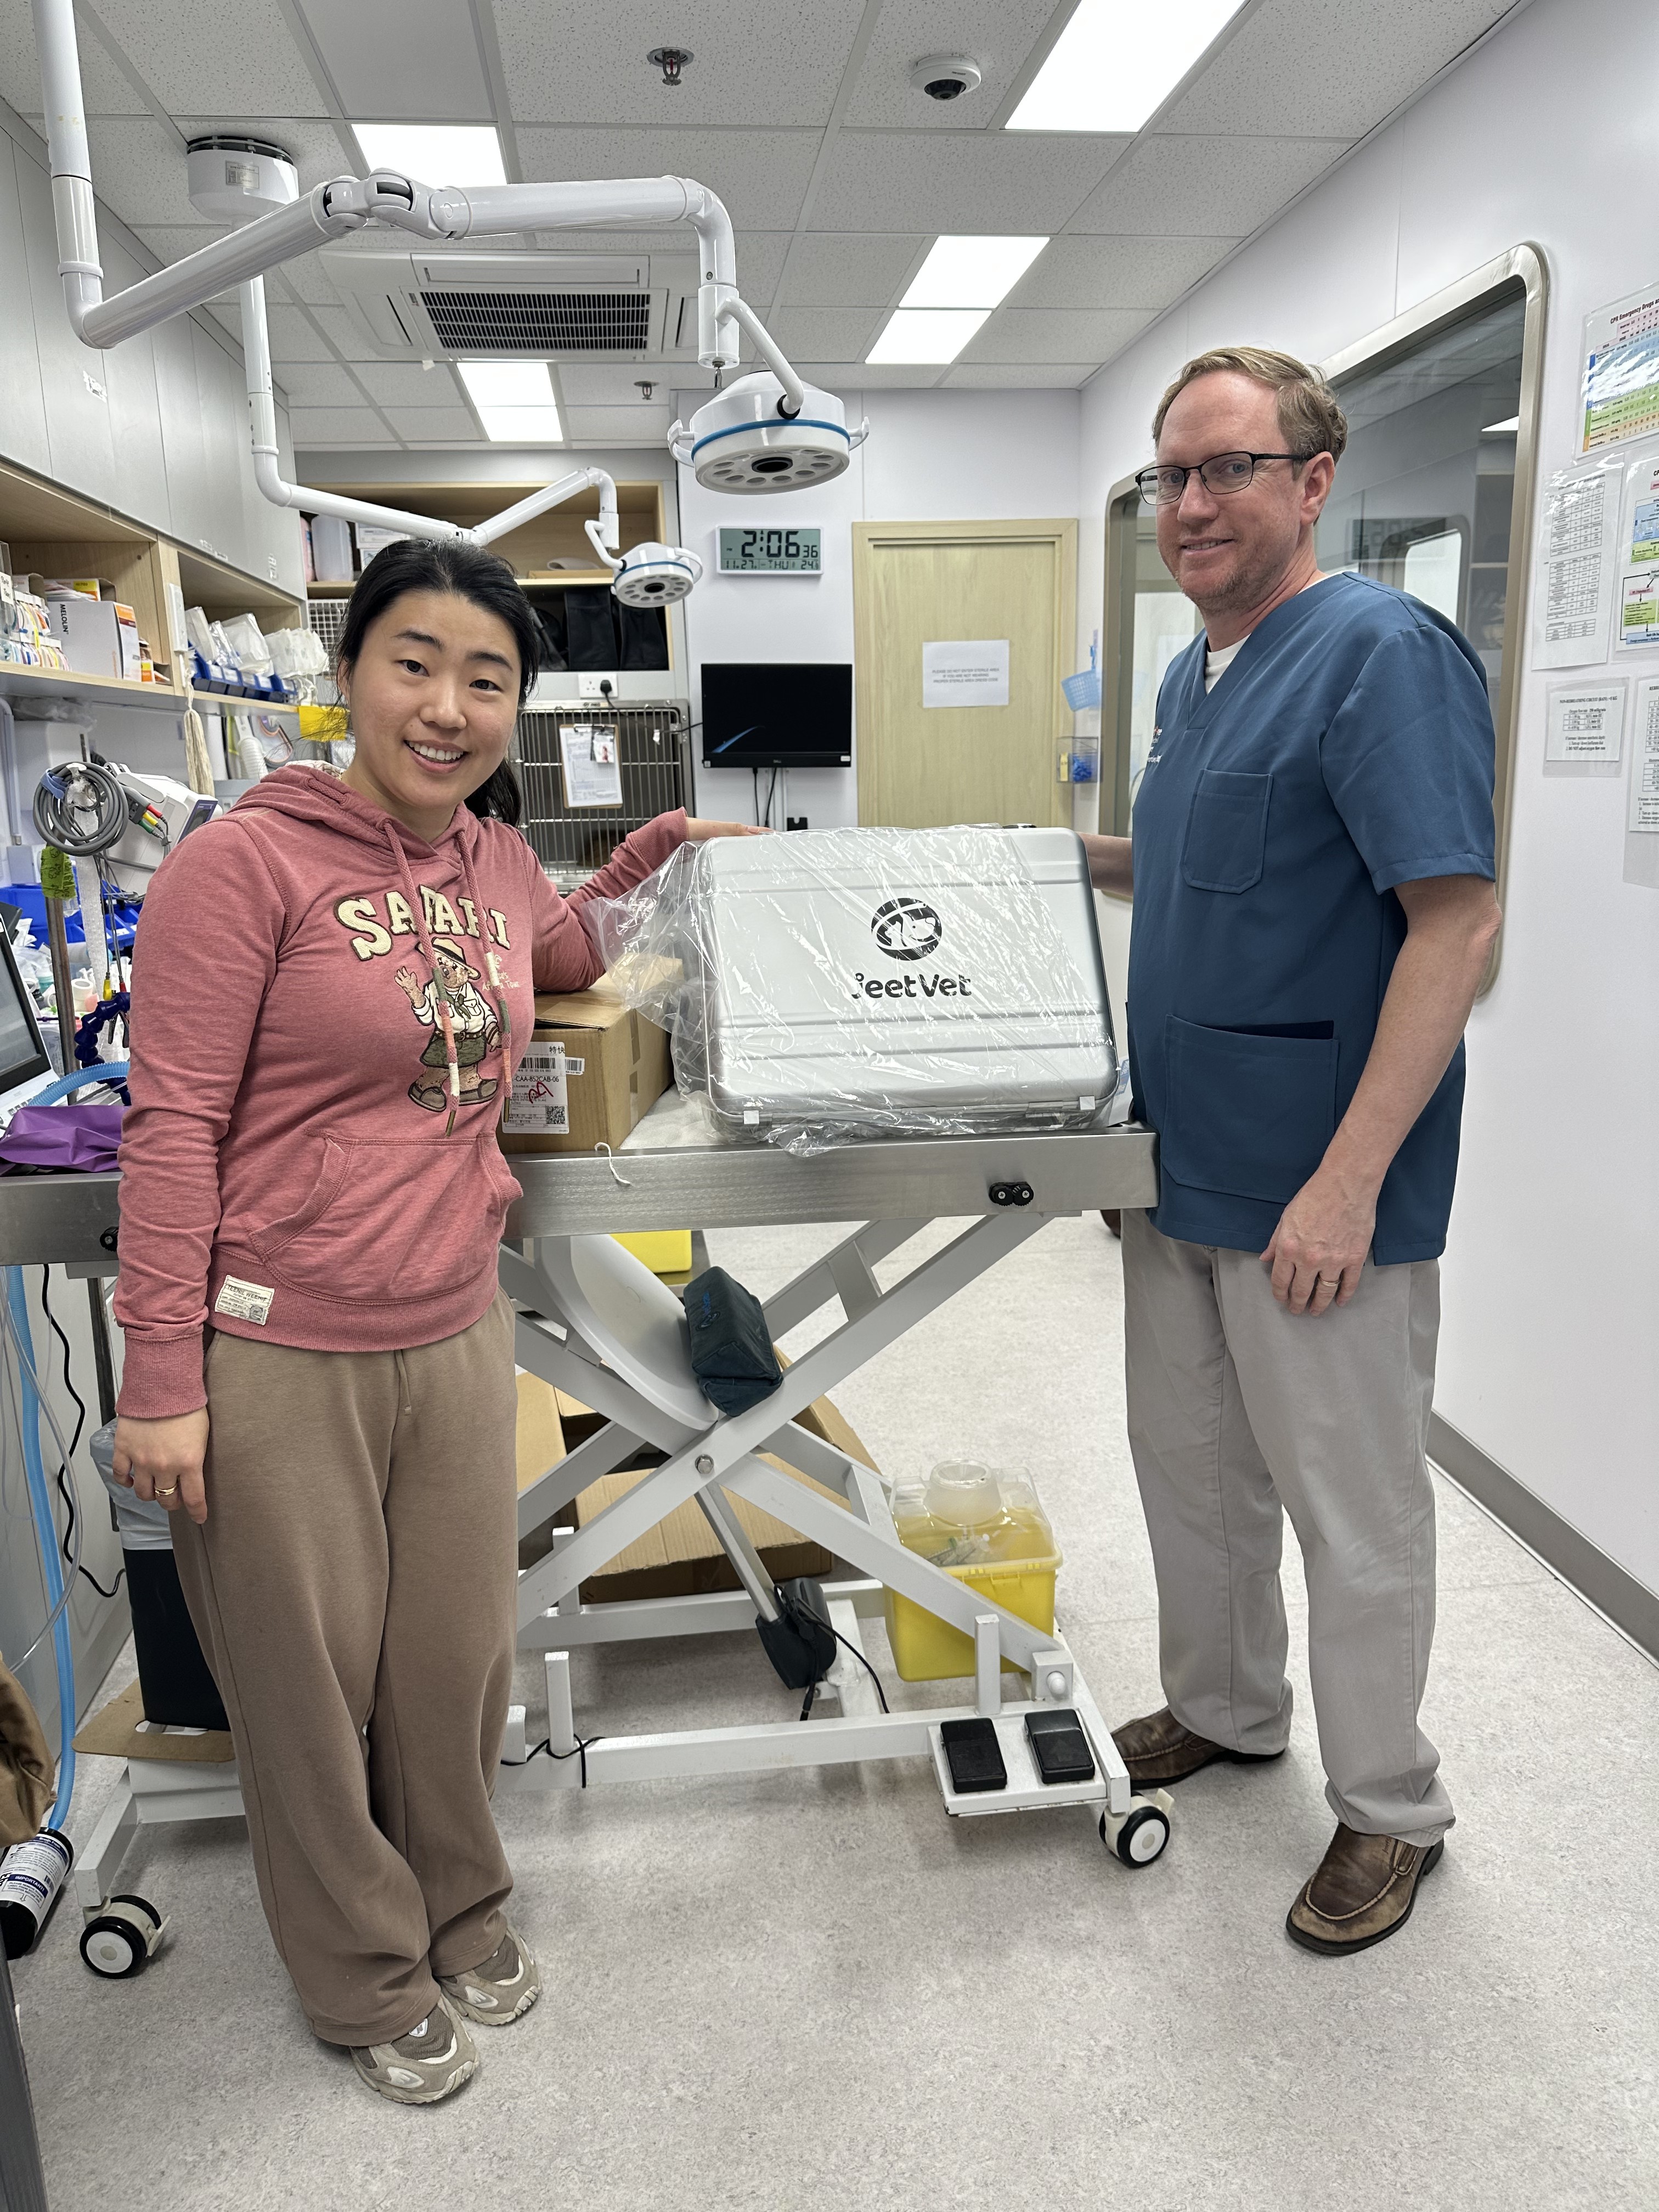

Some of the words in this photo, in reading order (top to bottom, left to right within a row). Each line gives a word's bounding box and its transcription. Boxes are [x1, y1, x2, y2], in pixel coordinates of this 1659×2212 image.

[1619, 306, 1641, 320] Emergency
[1641, 301, 1654, 310] Drugs
[741, 531, 800, 558] 2:06
[802, 545, 819, 558] 36
[768, 560, 789, 570] THU
[60, 603, 69, 633] MELOLIN
[549, 1046, 566, 1054] 特快
[227, 1285, 245, 1295] TEENIE
[246, 1291, 268, 1301] WEENIE
